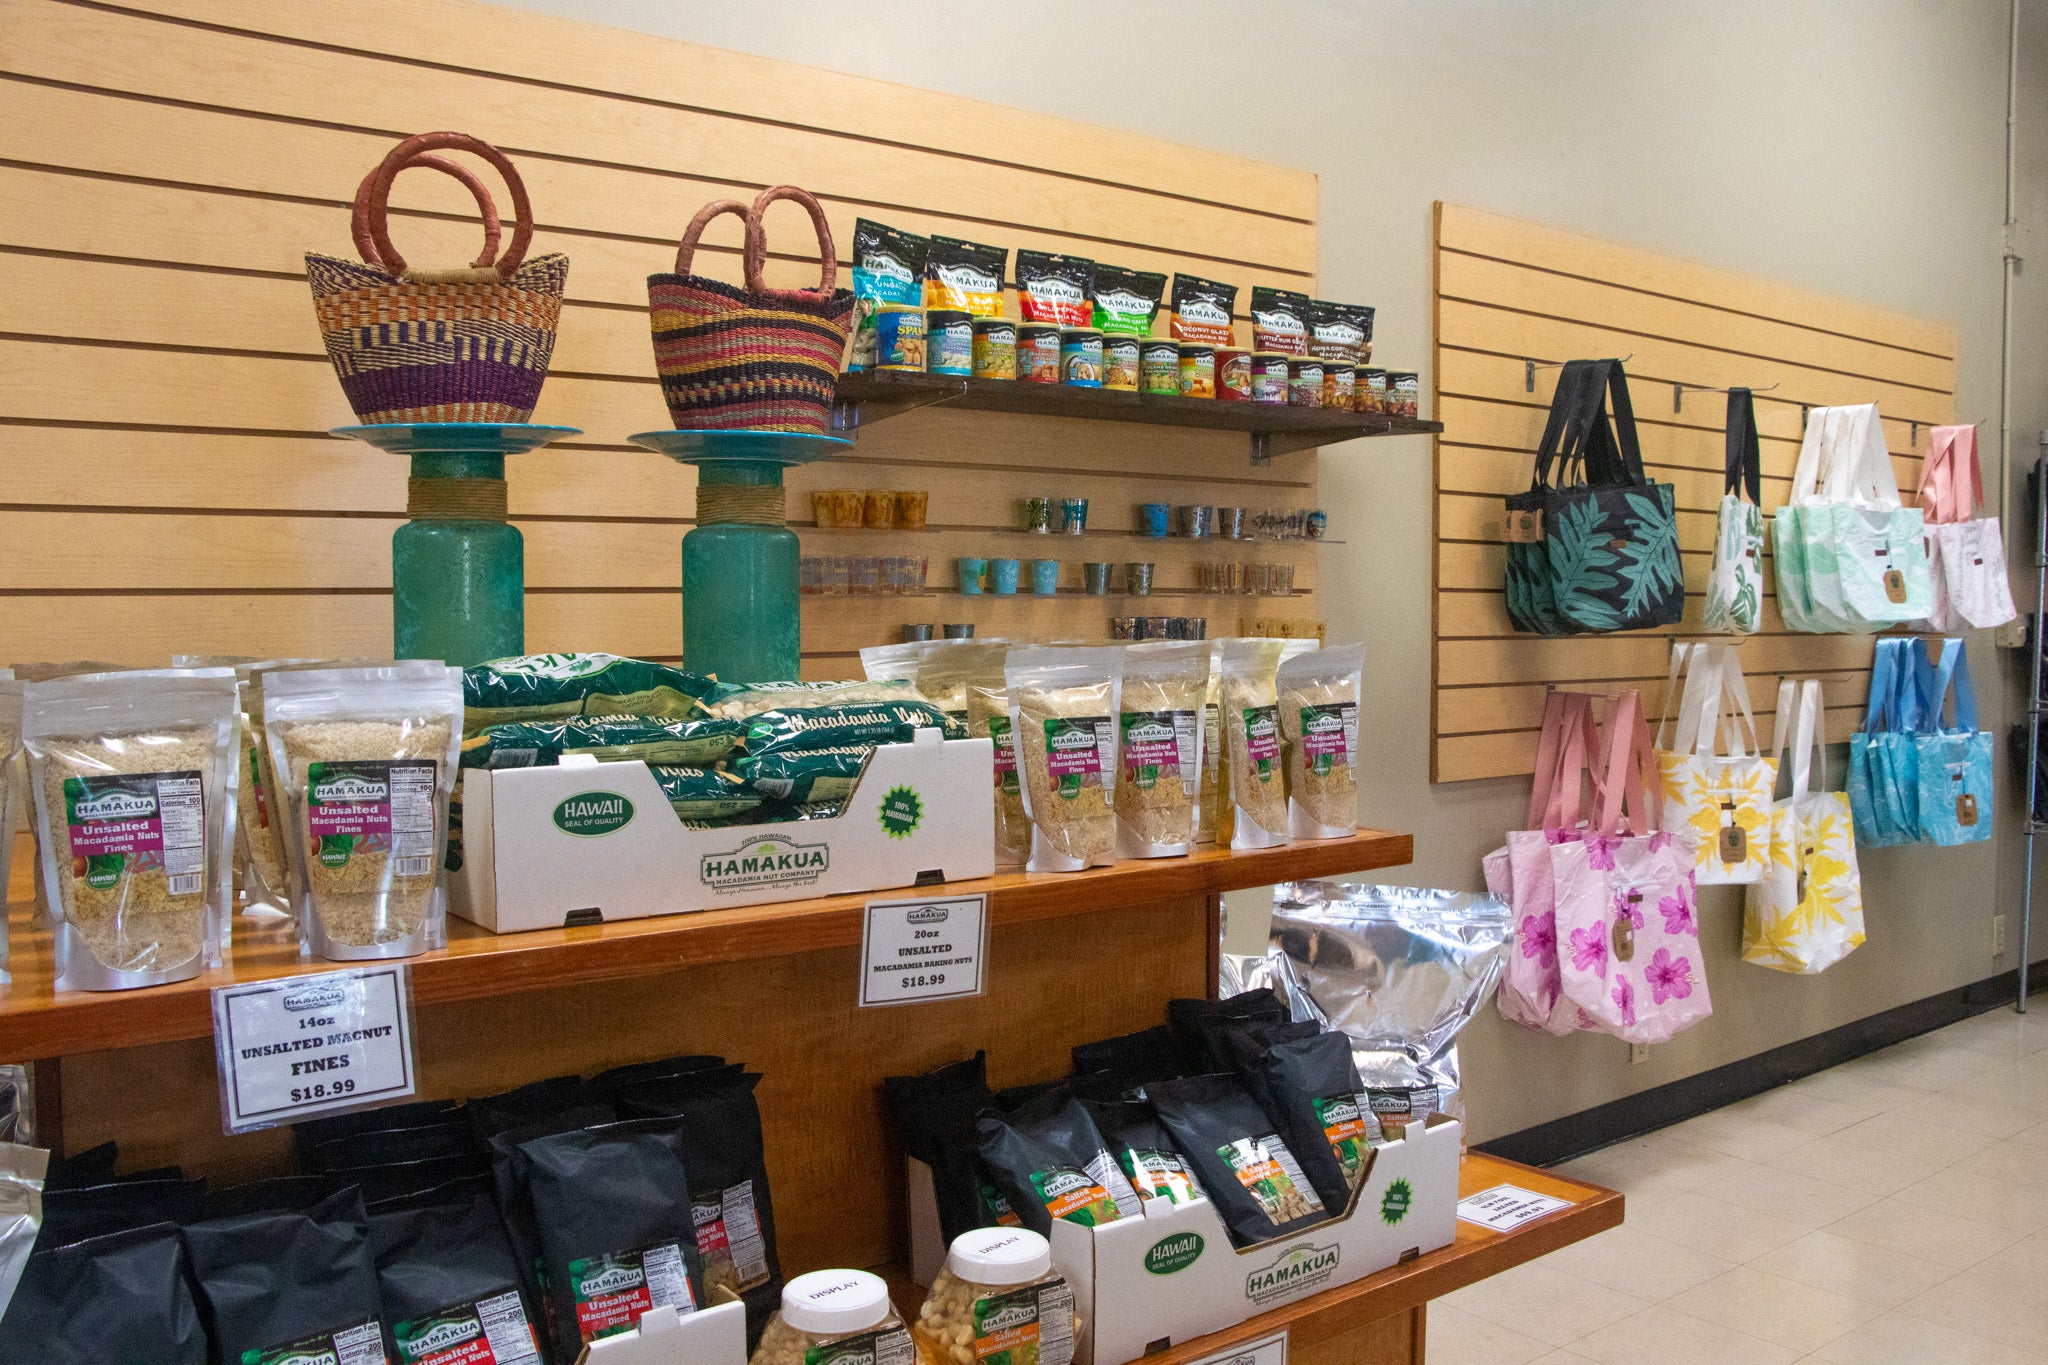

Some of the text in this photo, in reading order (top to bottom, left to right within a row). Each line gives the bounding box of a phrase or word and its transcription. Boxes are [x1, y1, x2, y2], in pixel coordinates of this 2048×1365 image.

[1031, 285, 1081, 299] HAMAKUA
[785, 707, 933, 732] Macadamia Nuts
[1308, 721, 1342, 729] HAMAKUA
[1053, 736, 1095, 745] HAMAKUA
[1056, 752, 1092, 760] Unsalted
[1126, 751, 1162, 759] Macadamia
[1051, 760, 1085, 768] Macadamia
[316, 786, 386, 796] HAMAKUA
[77, 800, 154, 814] HAMAKUA
[319, 805, 378, 815] Unsalted
[564, 800, 623, 818] HAWAII
[366, 815, 388, 823] Nuts
[82, 821, 149, 835] Unsalted
[336, 825, 362, 833] Fines
[74, 832, 159, 845] Macadamia Nuts
[104, 844, 133, 853] Fines
[705, 852, 824, 877] HAMAKUA
[716, 876, 761, 884] MACADAMIA
[781, 870, 814, 878] COMPANY
[909, 912, 946, 920] HAMAKUA
[914, 930, 939, 939] 20oz
[898, 944, 952, 956] UNSALTED
[874, 962, 922, 972] MACADAMIA
[924, 959, 953, 967] BAKING
[902, 974, 945, 988] $18.99
[286, 993, 342, 1006] HAMAKUA
[299, 1016, 335, 1029] 14oz
[241, 1025, 392, 1059] UNSALTED MACNUT
[291, 1055, 350, 1076] FINES
[290, 1079, 355, 1103] $18.99
[1325, 1108, 1358, 1120] HAMAKUA
[1064, 1189, 1089, 1203] Salted
[694, 1207, 719, 1220] AKUA
[1053, 1197, 1092, 1217] Macadamia
[699, 1245, 709, 1254] ced
[979, 1237, 1020, 1254] DISPLAY
[1153, 1236, 1196, 1261] HAWAII
[1152, 1262, 1165, 1270] SEAL
[1175, 1253, 1196, 1263] QUALITY
[1250, 1252, 1335, 1292] HAMAKUA
[583, 1271, 641, 1292] HAMAKUA
[1257, 1282, 1289, 1296] MACADAMIA
[1303, 1269, 1328, 1280] COMPANY
[809, 1281, 859, 1300] DISPLAY
[477, 1298, 501, 1308] Nutrition
[502, 1292, 517, 1301] Facts
[588, 1291, 639, 1311] Unsalted
[483, 1309, 522, 1327] Calories 200
[581, 1300, 649, 1322] Macadamia Nuts
[983, 1308, 1035, 1328] HAMAKUA
[608, 1314, 629, 1326] Diced
[335, 1328, 363, 1341] Nutrition
[364, 1323, 378, 1332] Facts
[410, 1322, 478, 1352] HAMAKUA
[994, 1330, 1021, 1341] Salted
[368, 1342, 382, 1350] 200
[979, 1339, 1019, 1354] Macadamia
[468, 1351, 490, 1362] Nuts
